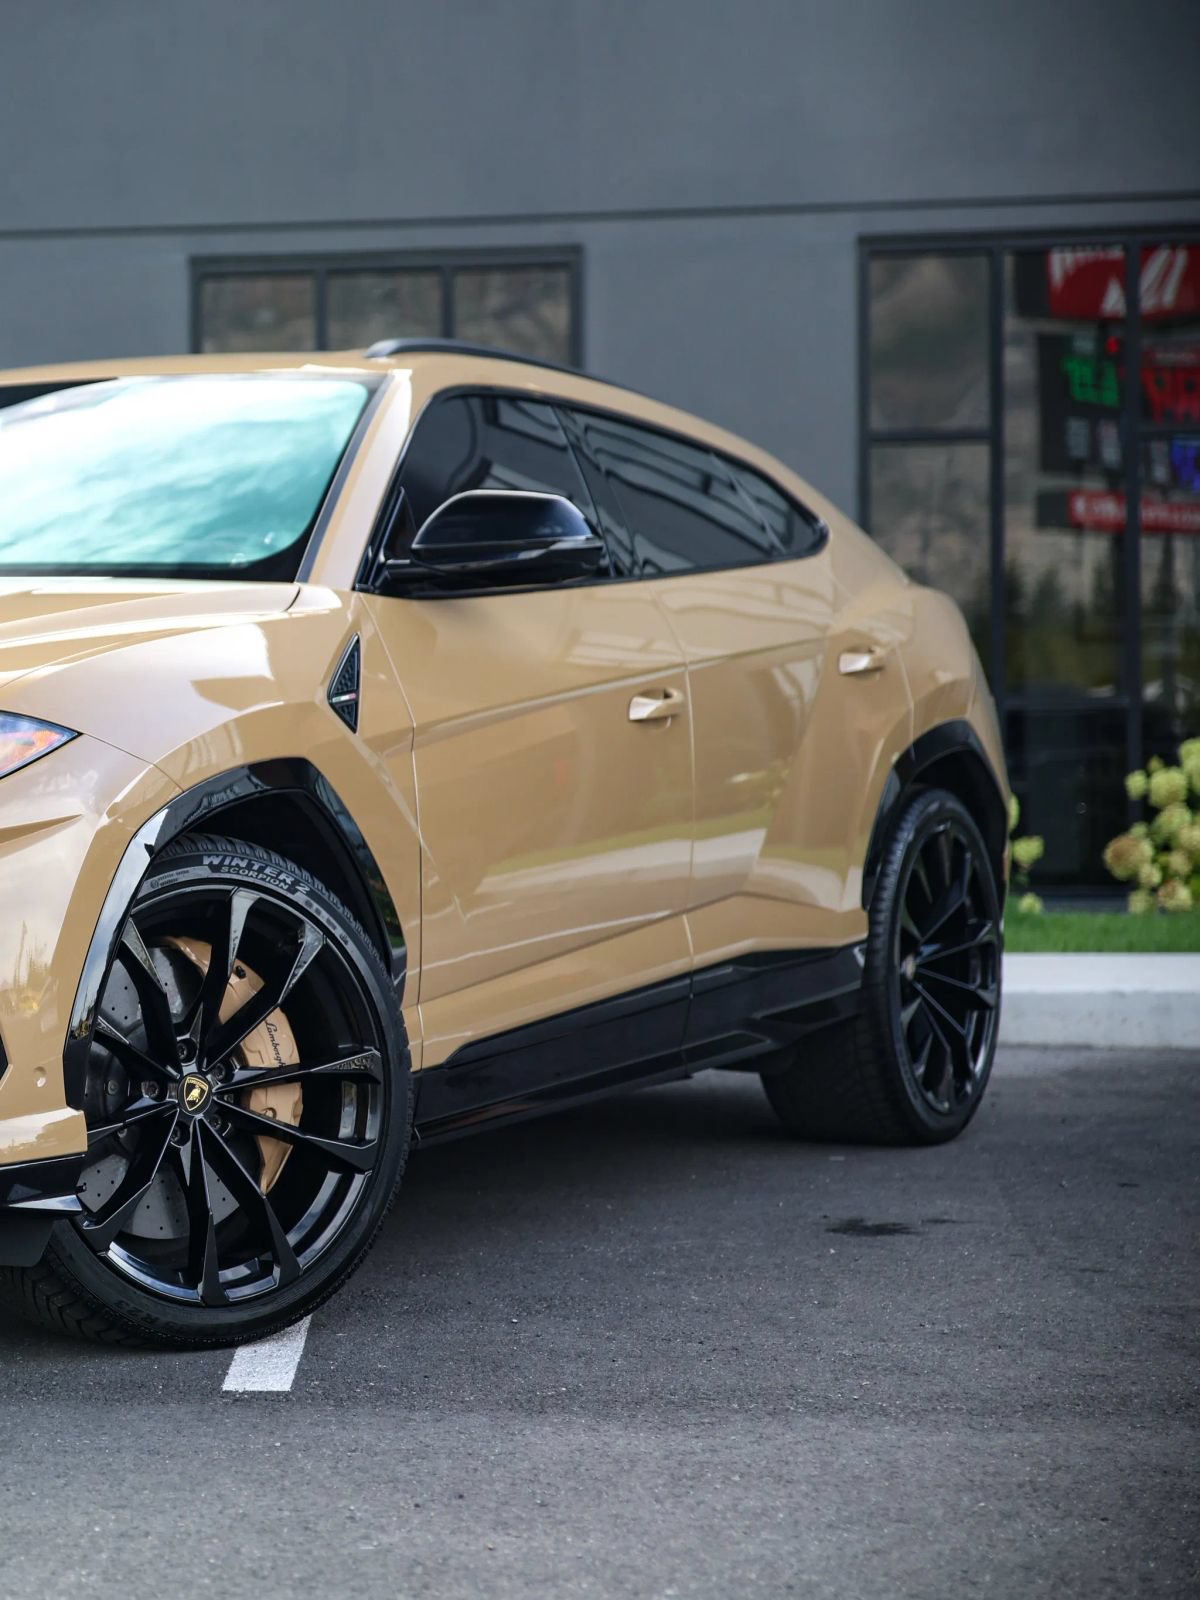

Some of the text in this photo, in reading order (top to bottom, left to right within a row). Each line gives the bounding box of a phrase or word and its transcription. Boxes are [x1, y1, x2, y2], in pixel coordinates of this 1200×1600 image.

[202, 855, 295, 884] WINTER
[295, 882, 311, 894] 2
[220, 866, 289, 890] SCORPION
[264, 1020, 287, 1067] Lamborgh
